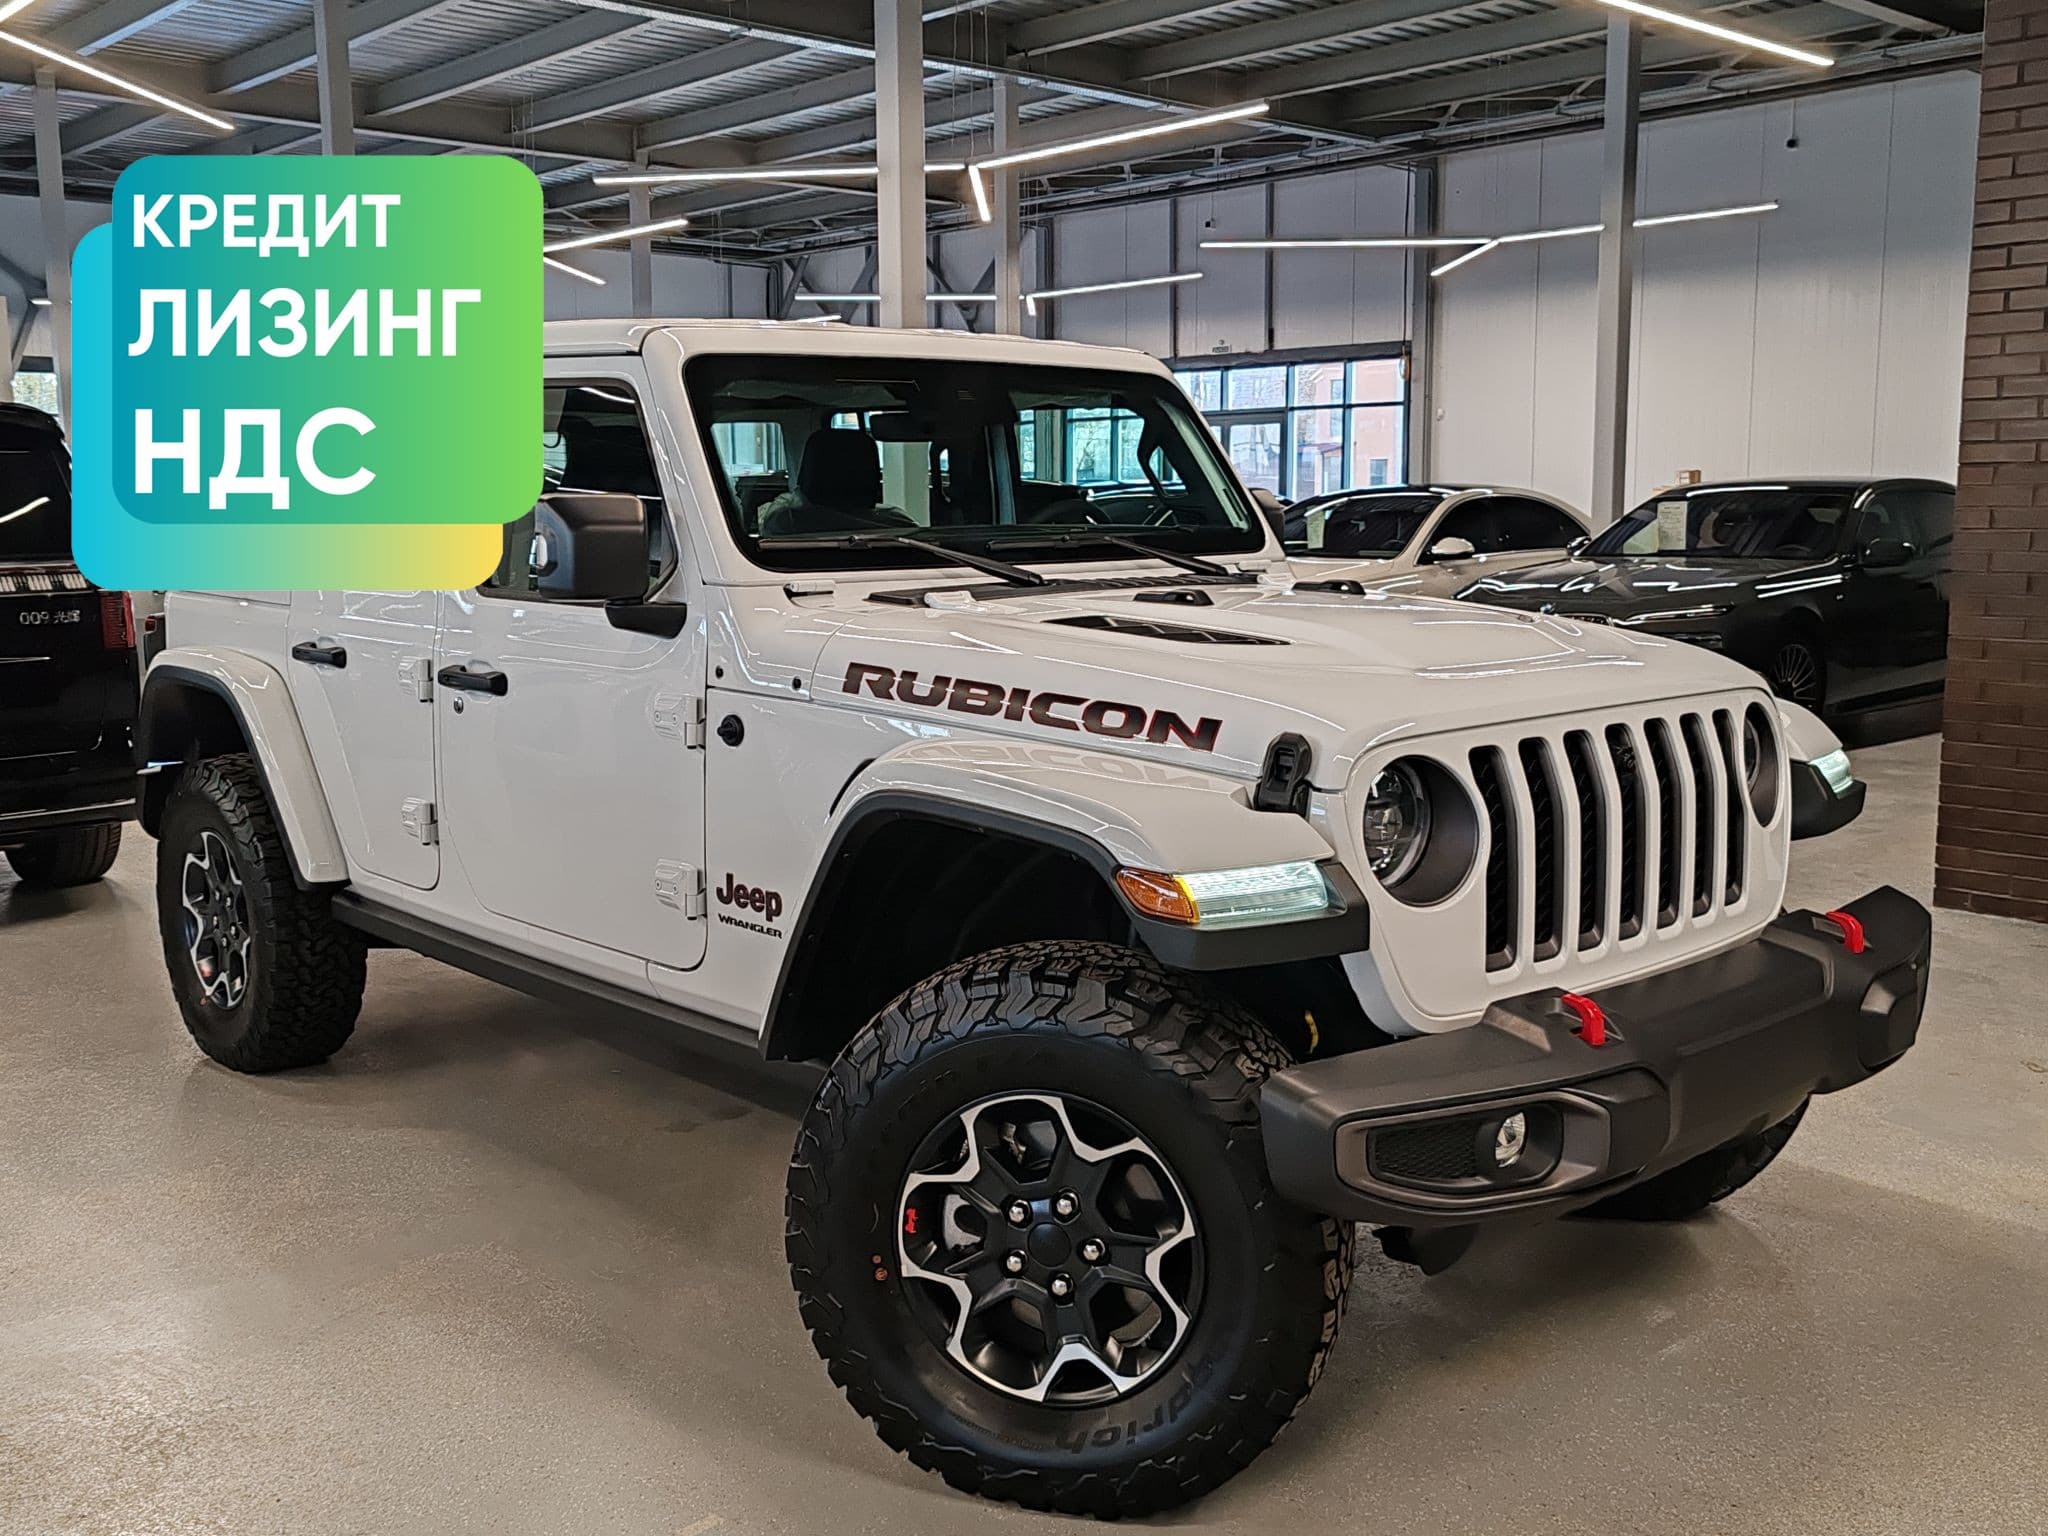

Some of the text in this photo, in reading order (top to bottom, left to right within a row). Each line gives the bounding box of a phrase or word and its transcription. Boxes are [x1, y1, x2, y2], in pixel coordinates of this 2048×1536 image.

[20, 611, 49, 624] 009
[842, 662, 1223, 752] RUBICON
[716, 872, 783, 923] Jeep
[718, 912, 782, 939] WRANGLER
